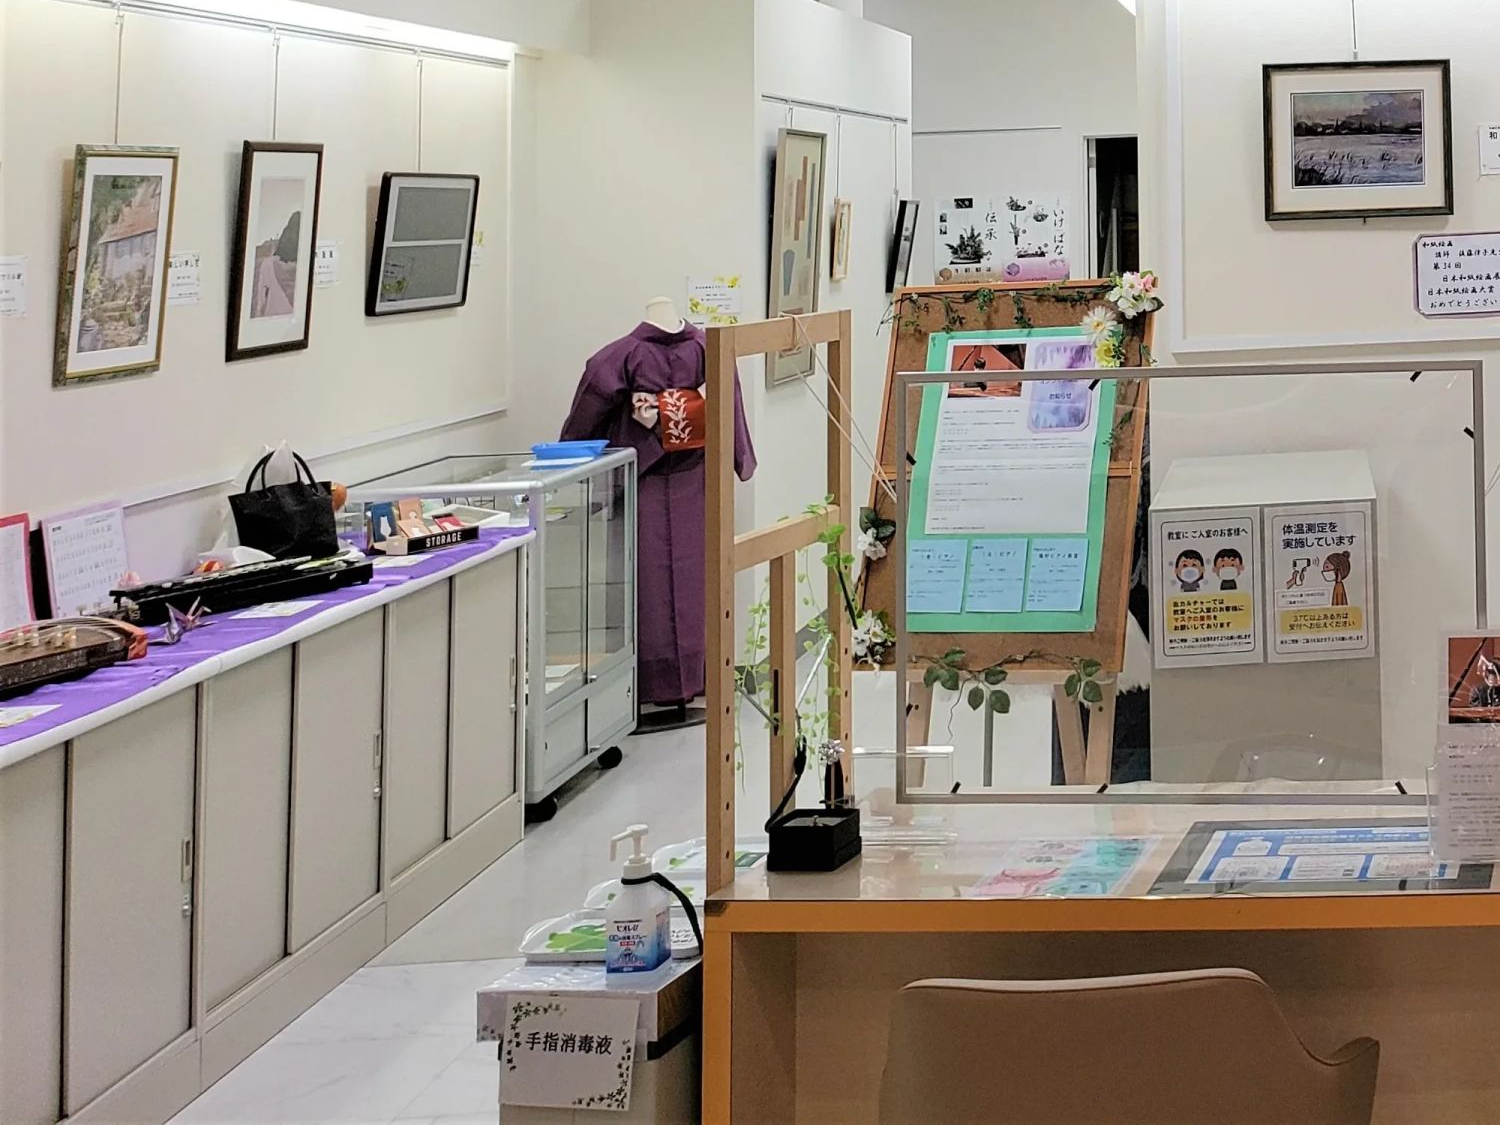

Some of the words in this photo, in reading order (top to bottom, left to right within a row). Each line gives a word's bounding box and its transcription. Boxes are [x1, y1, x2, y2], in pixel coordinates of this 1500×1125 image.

[1282, 521, 1338, 536] 体温測定を
[425, 531, 462, 548] STORAGE
[1282, 534, 1357, 550] 実施しています
[525, 1031, 613, 1056] 手指消毒液
